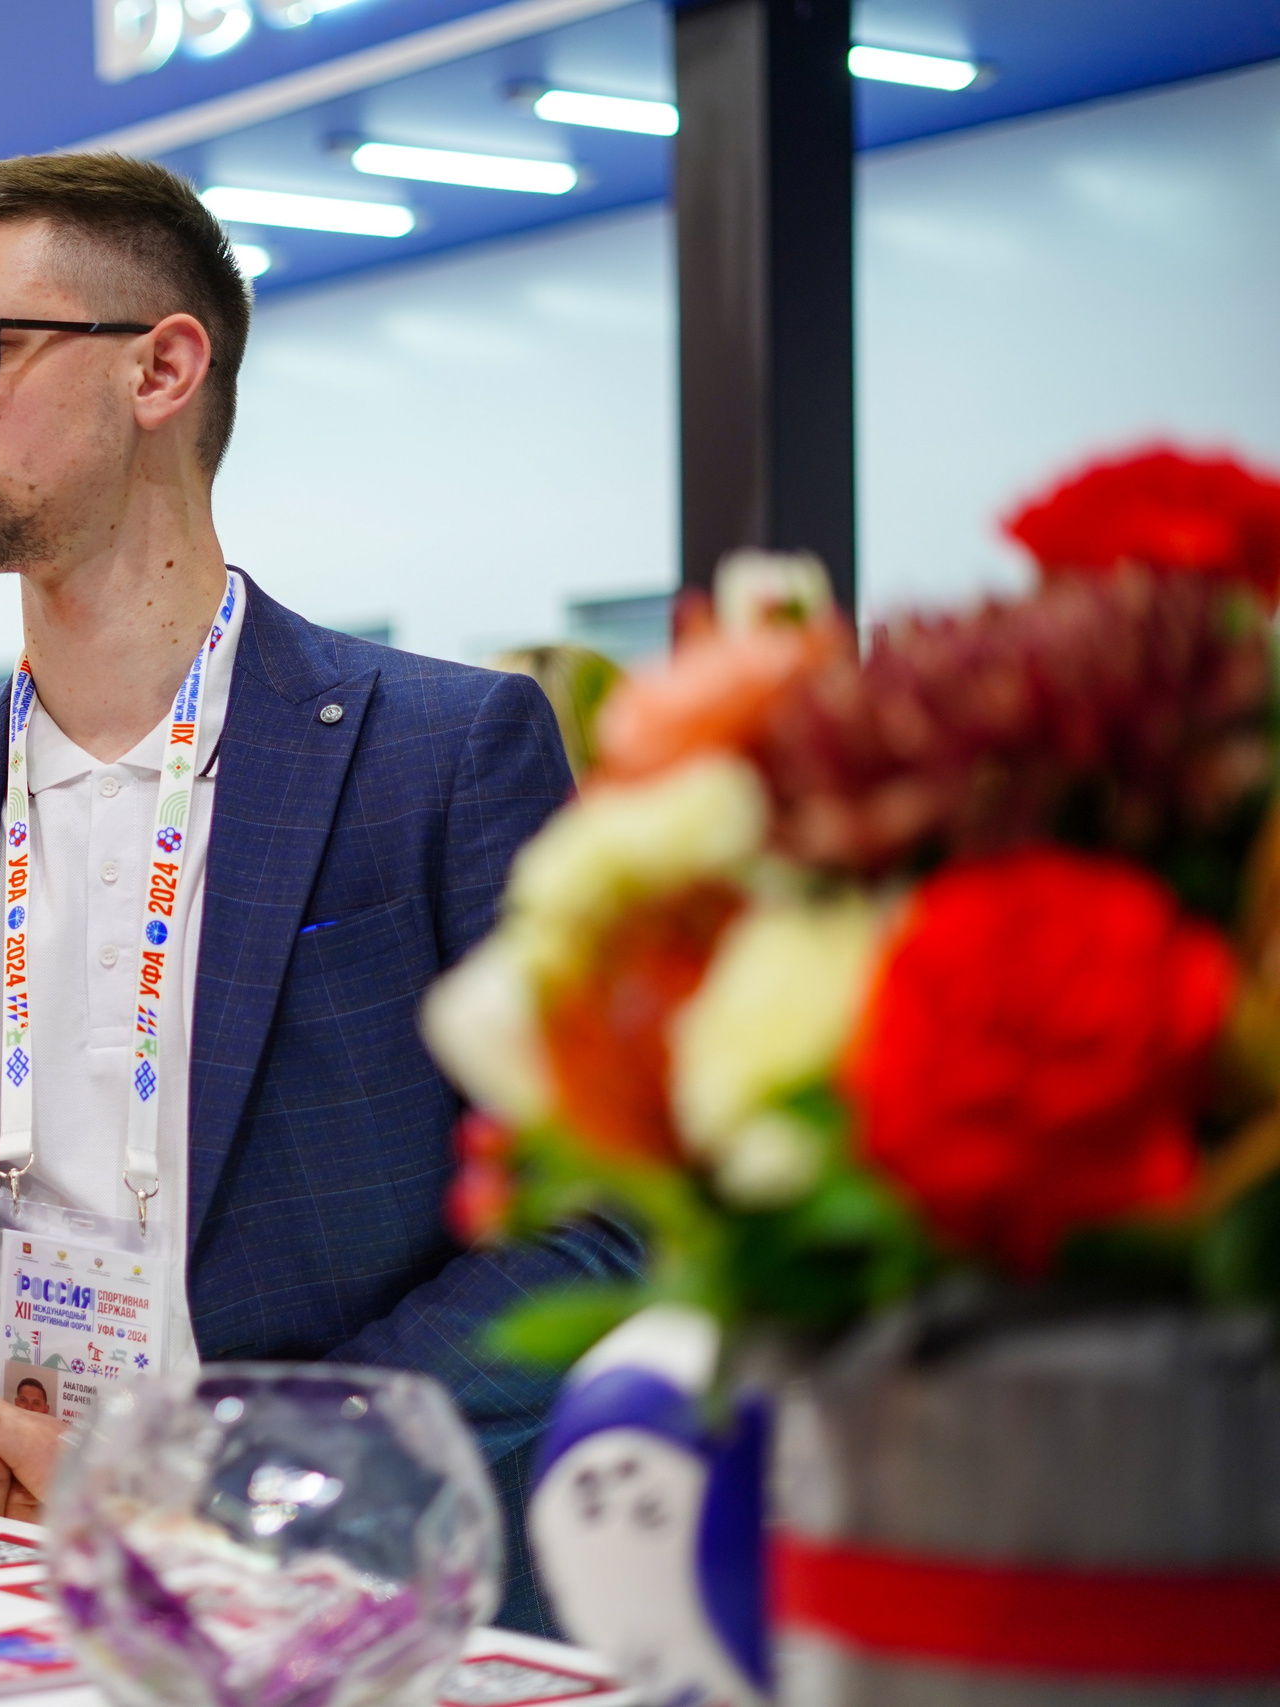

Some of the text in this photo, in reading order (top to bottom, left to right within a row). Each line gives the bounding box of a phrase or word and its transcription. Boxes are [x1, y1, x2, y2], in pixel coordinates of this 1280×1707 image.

[20, 655, 31, 676] II
[12, 672, 28, 715] СПОРТИВНЫЙ
[186, 673, 200, 721] СПОРТИВНЫЙ
[17, 677, 35, 732] ЖДУНАРОДНЫЙ
[170, 724, 195, 745] XII
[6, 854, 28, 987] УФА 2024
[139, 862, 179, 999] УФА 2024
[16, 1272, 96, 1310] РОССИЯ
[97, 1290, 149, 1309] СПОРТИВНАЯ
[15, 1300, 31, 1320] XII
[33, 1304, 86, 1321] МЕЖДУНАРОДНЫЙ
[97, 1302, 136, 1319] ДЕРЖАВА
[32, 1315, 91, 1332] СПОРТИВНЫЙ ФОРУМ
[97, 1324, 147, 1343] УФА 2024
[63, 1381, 97, 1395] АНАТОЛИЙ
[63, 1392, 91, 1405] БОГАЧЕВ
